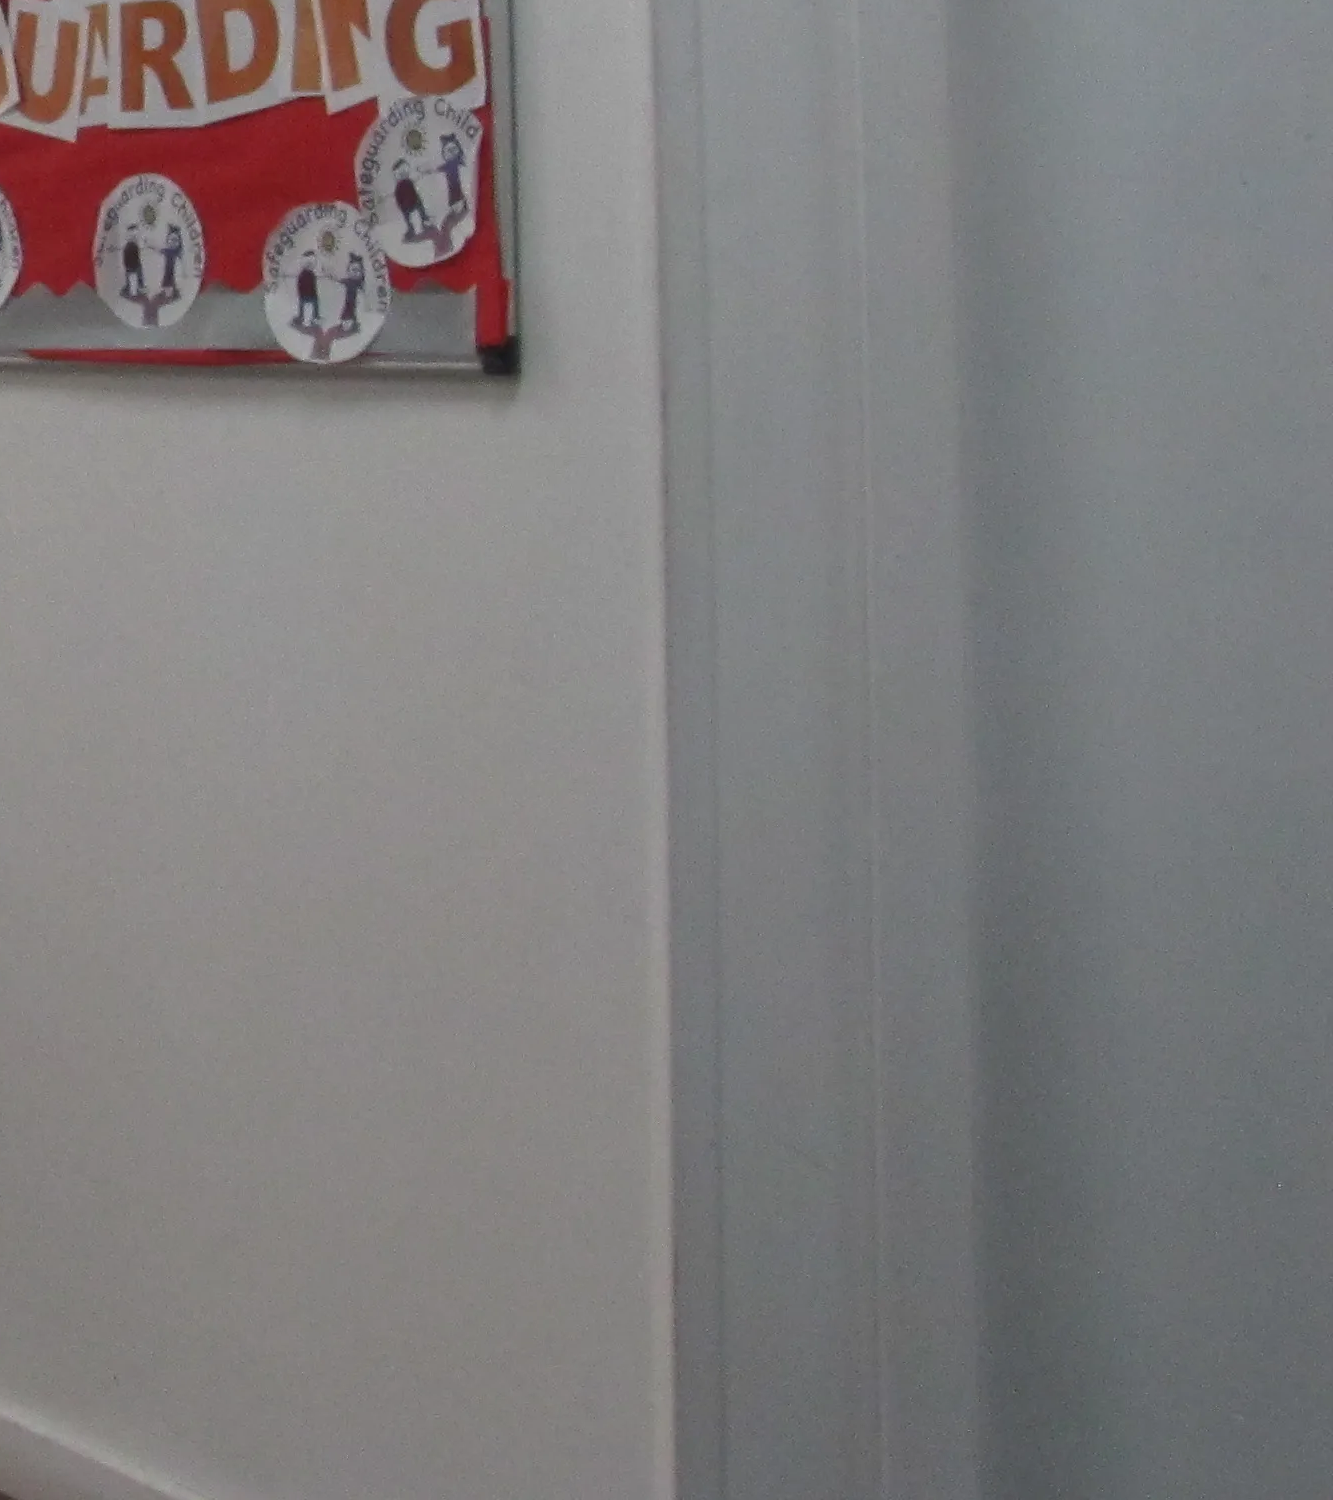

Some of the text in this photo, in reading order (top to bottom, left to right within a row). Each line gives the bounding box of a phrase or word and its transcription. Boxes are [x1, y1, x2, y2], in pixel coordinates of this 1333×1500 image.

[359, 100, 426, 225] Safeguarding
[170, 192, 204, 278] Children
[264, 203, 348, 294] Safeguarding
